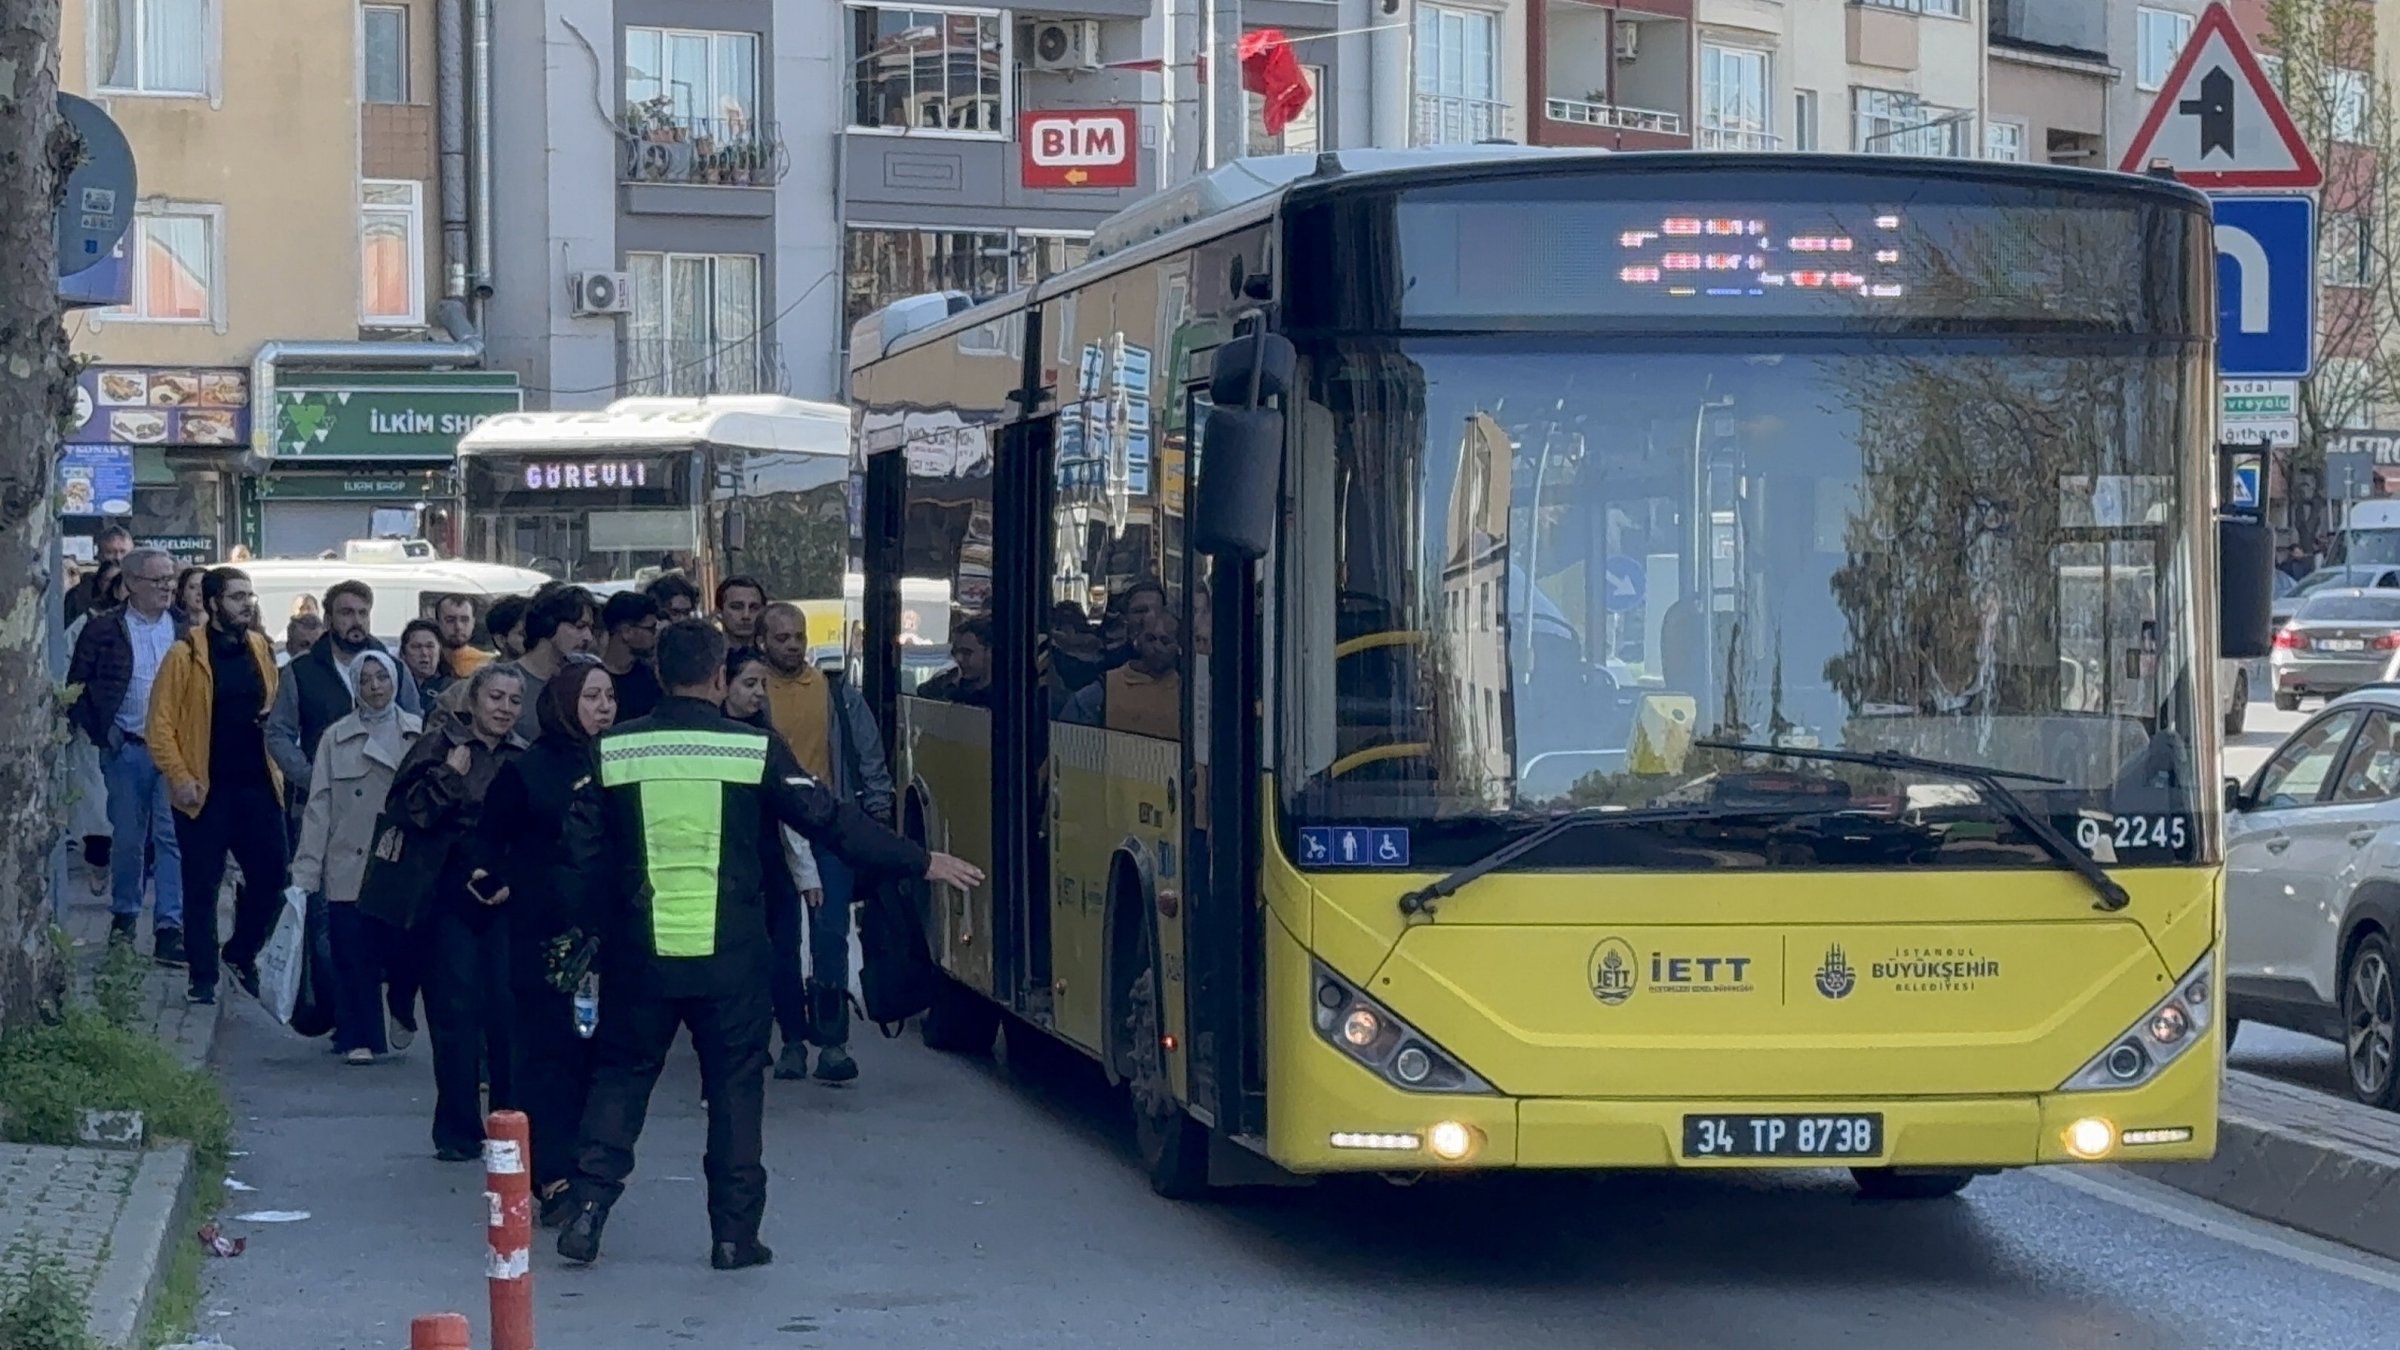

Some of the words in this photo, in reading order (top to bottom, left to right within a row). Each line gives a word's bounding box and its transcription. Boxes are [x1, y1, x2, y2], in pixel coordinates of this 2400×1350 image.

[370, 408, 434, 434] İLKİM
[1896, 947, 1975, 957] İSTANBUL
[1652, 952, 1751, 982] İETT
[1872, 956, 2000, 983] BÜYÜKŞEHİR
[1896, 982, 1975, 992] BELEDİYESİ
[1697, 1119, 1735, 1153] 34
[1750, 1118, 1786, 1152] TP
[1798, 1118, 1872, 1152] 8738
